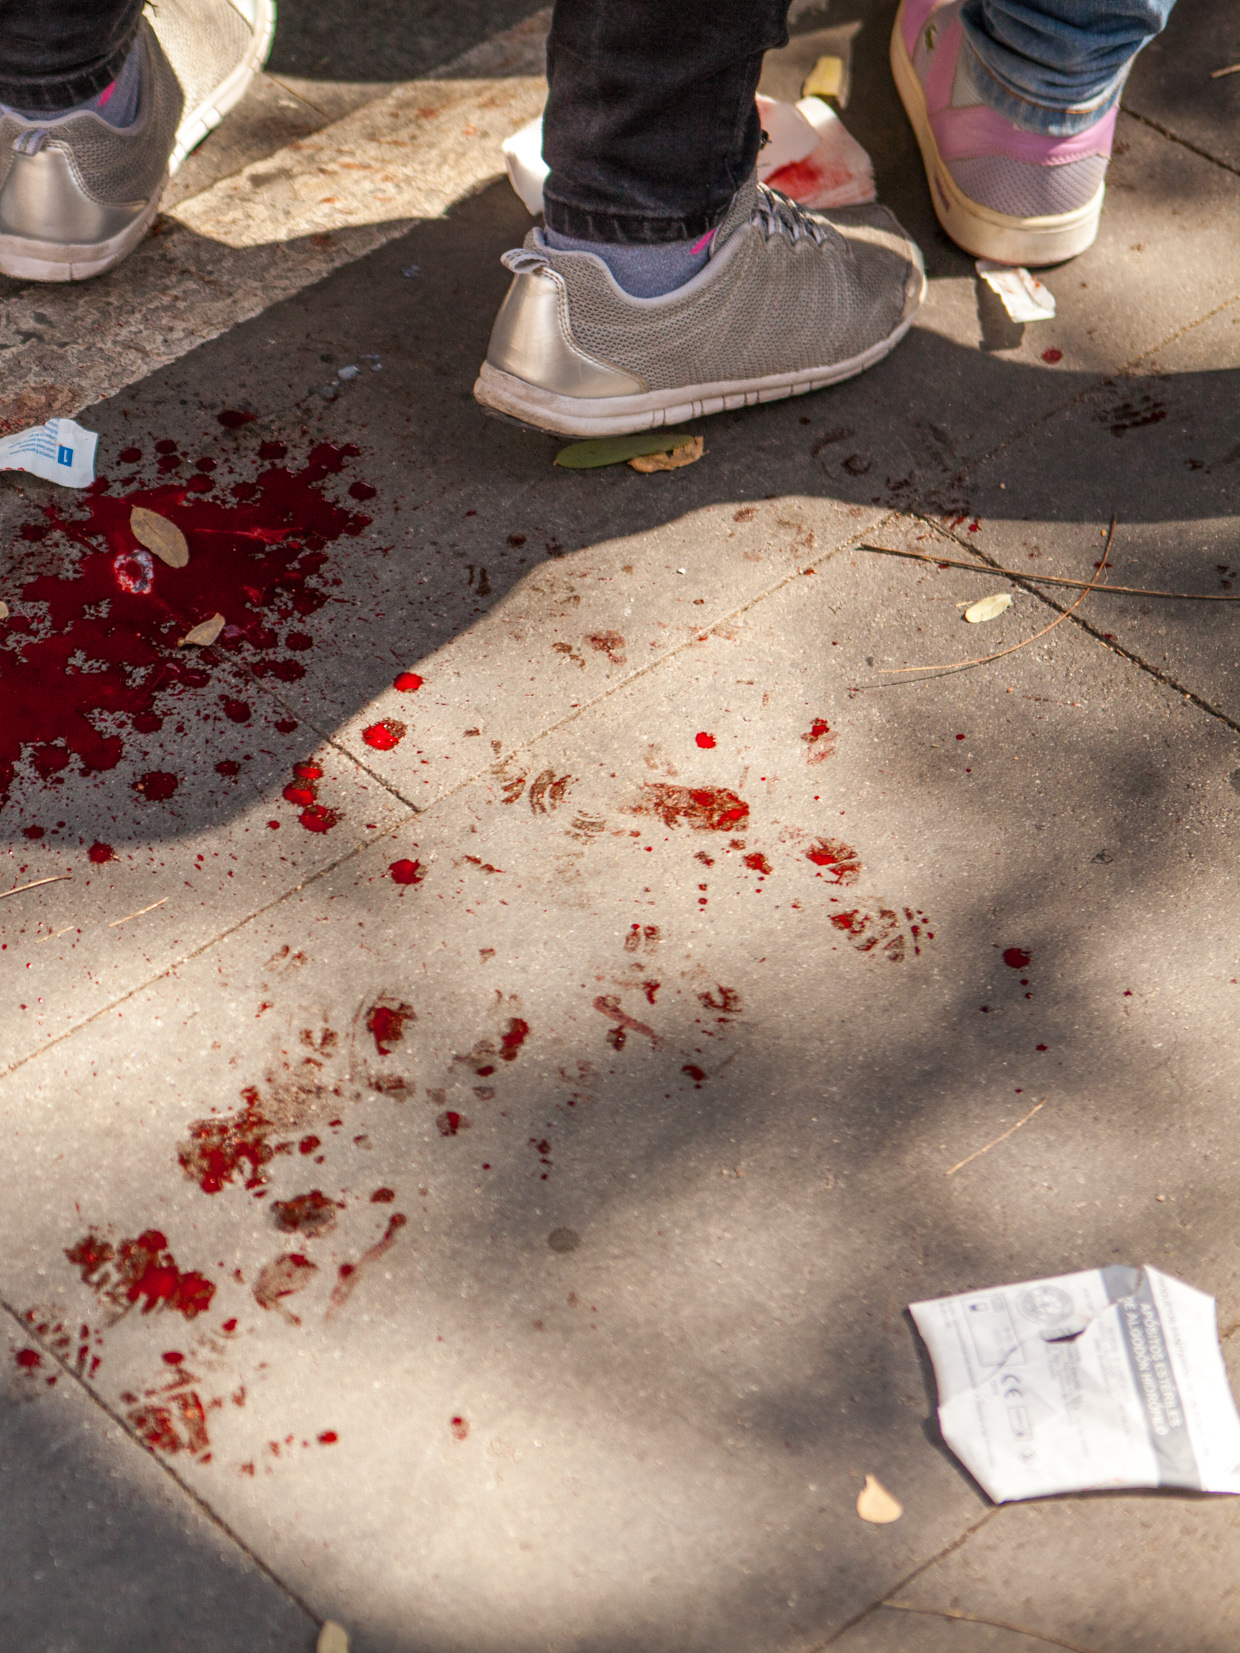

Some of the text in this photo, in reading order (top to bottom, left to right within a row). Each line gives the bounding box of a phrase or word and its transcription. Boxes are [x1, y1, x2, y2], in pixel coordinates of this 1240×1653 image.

[998, 1370, 1024, 1402] CE
[1124, 1310, 1154, 1372] ALGODÓN
[1140, 1371, 1170, 1437] HIDRÓFILO
[1137, 1301, 1184, 1429] APÓSITOS ESTÉRILES
